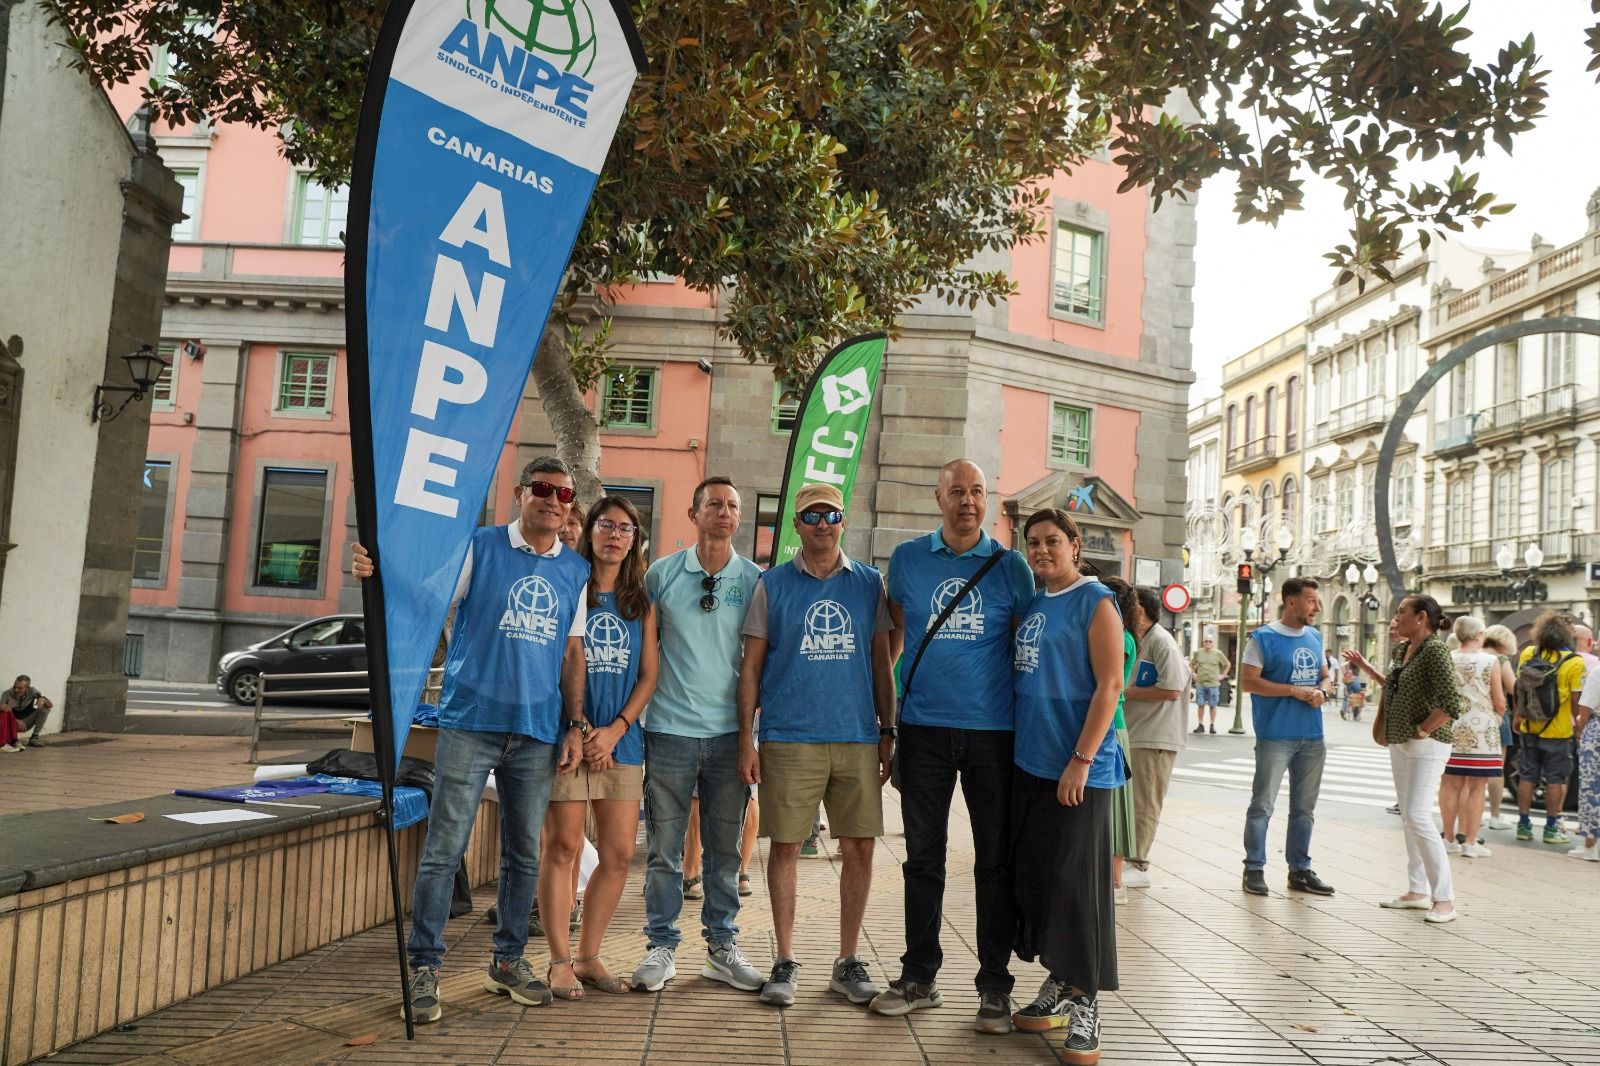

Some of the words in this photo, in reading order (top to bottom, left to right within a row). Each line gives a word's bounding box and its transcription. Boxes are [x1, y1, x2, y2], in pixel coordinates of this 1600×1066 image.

[436, 51, 498, 89] SINDICATO
[500, 84, 586, 128] INDEPENDIENTE
[438, 18, 594, 119] ANPE
[427, 126, 554, 194] CANARIAS
[394, 180, 512, 519] ANPE
[498, 609, 559, 637] ANPE
[505, 631, 548, 645] CANARIAS
[799, 633, 856, 651] ANPE
